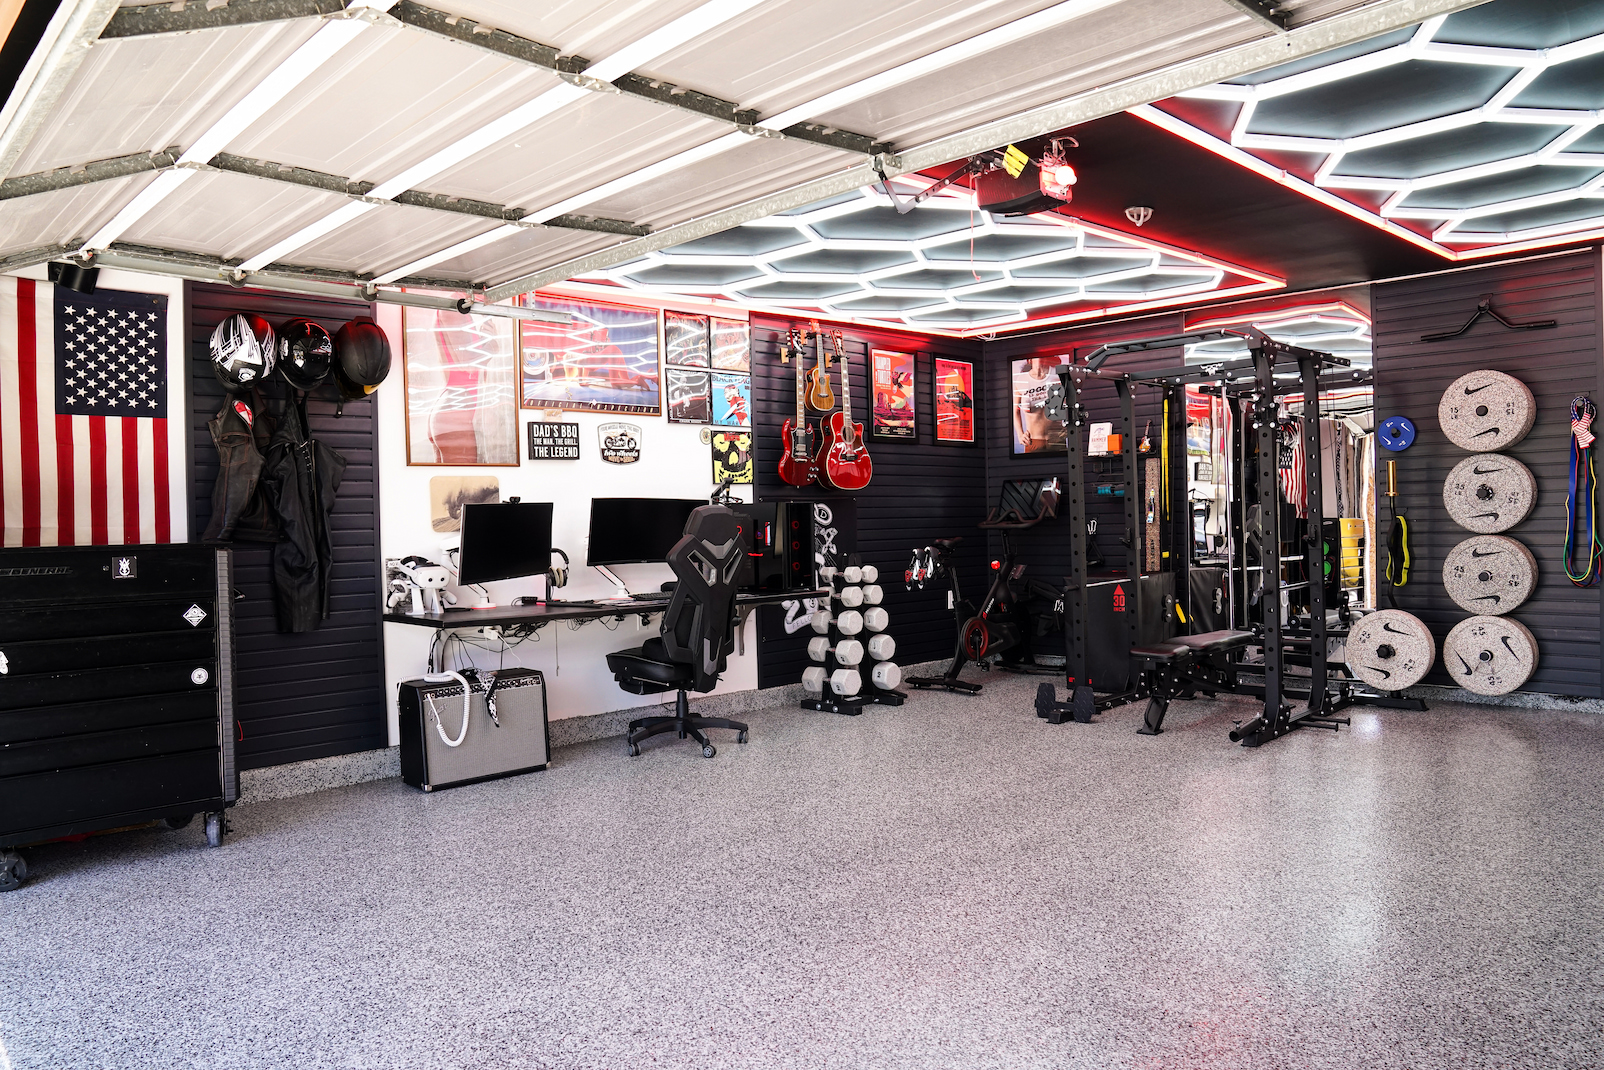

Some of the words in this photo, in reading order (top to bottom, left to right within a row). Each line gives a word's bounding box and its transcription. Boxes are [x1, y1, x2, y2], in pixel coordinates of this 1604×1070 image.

[530, 399, 583, 409] OFFICIAL
[590, 403, 654, 413] INSPECTION
[533, 424, 558, 438] DAD'S
[561, 425, 577, 438] BBQ
[534, 446, 549, 458] THE
[550, 446, 578, 458] LEGEND
[9, 566, 74, 576] GENERAL
[1113, 595, 1125, 607] 30
[792, 614, 812, 630] FELLO
